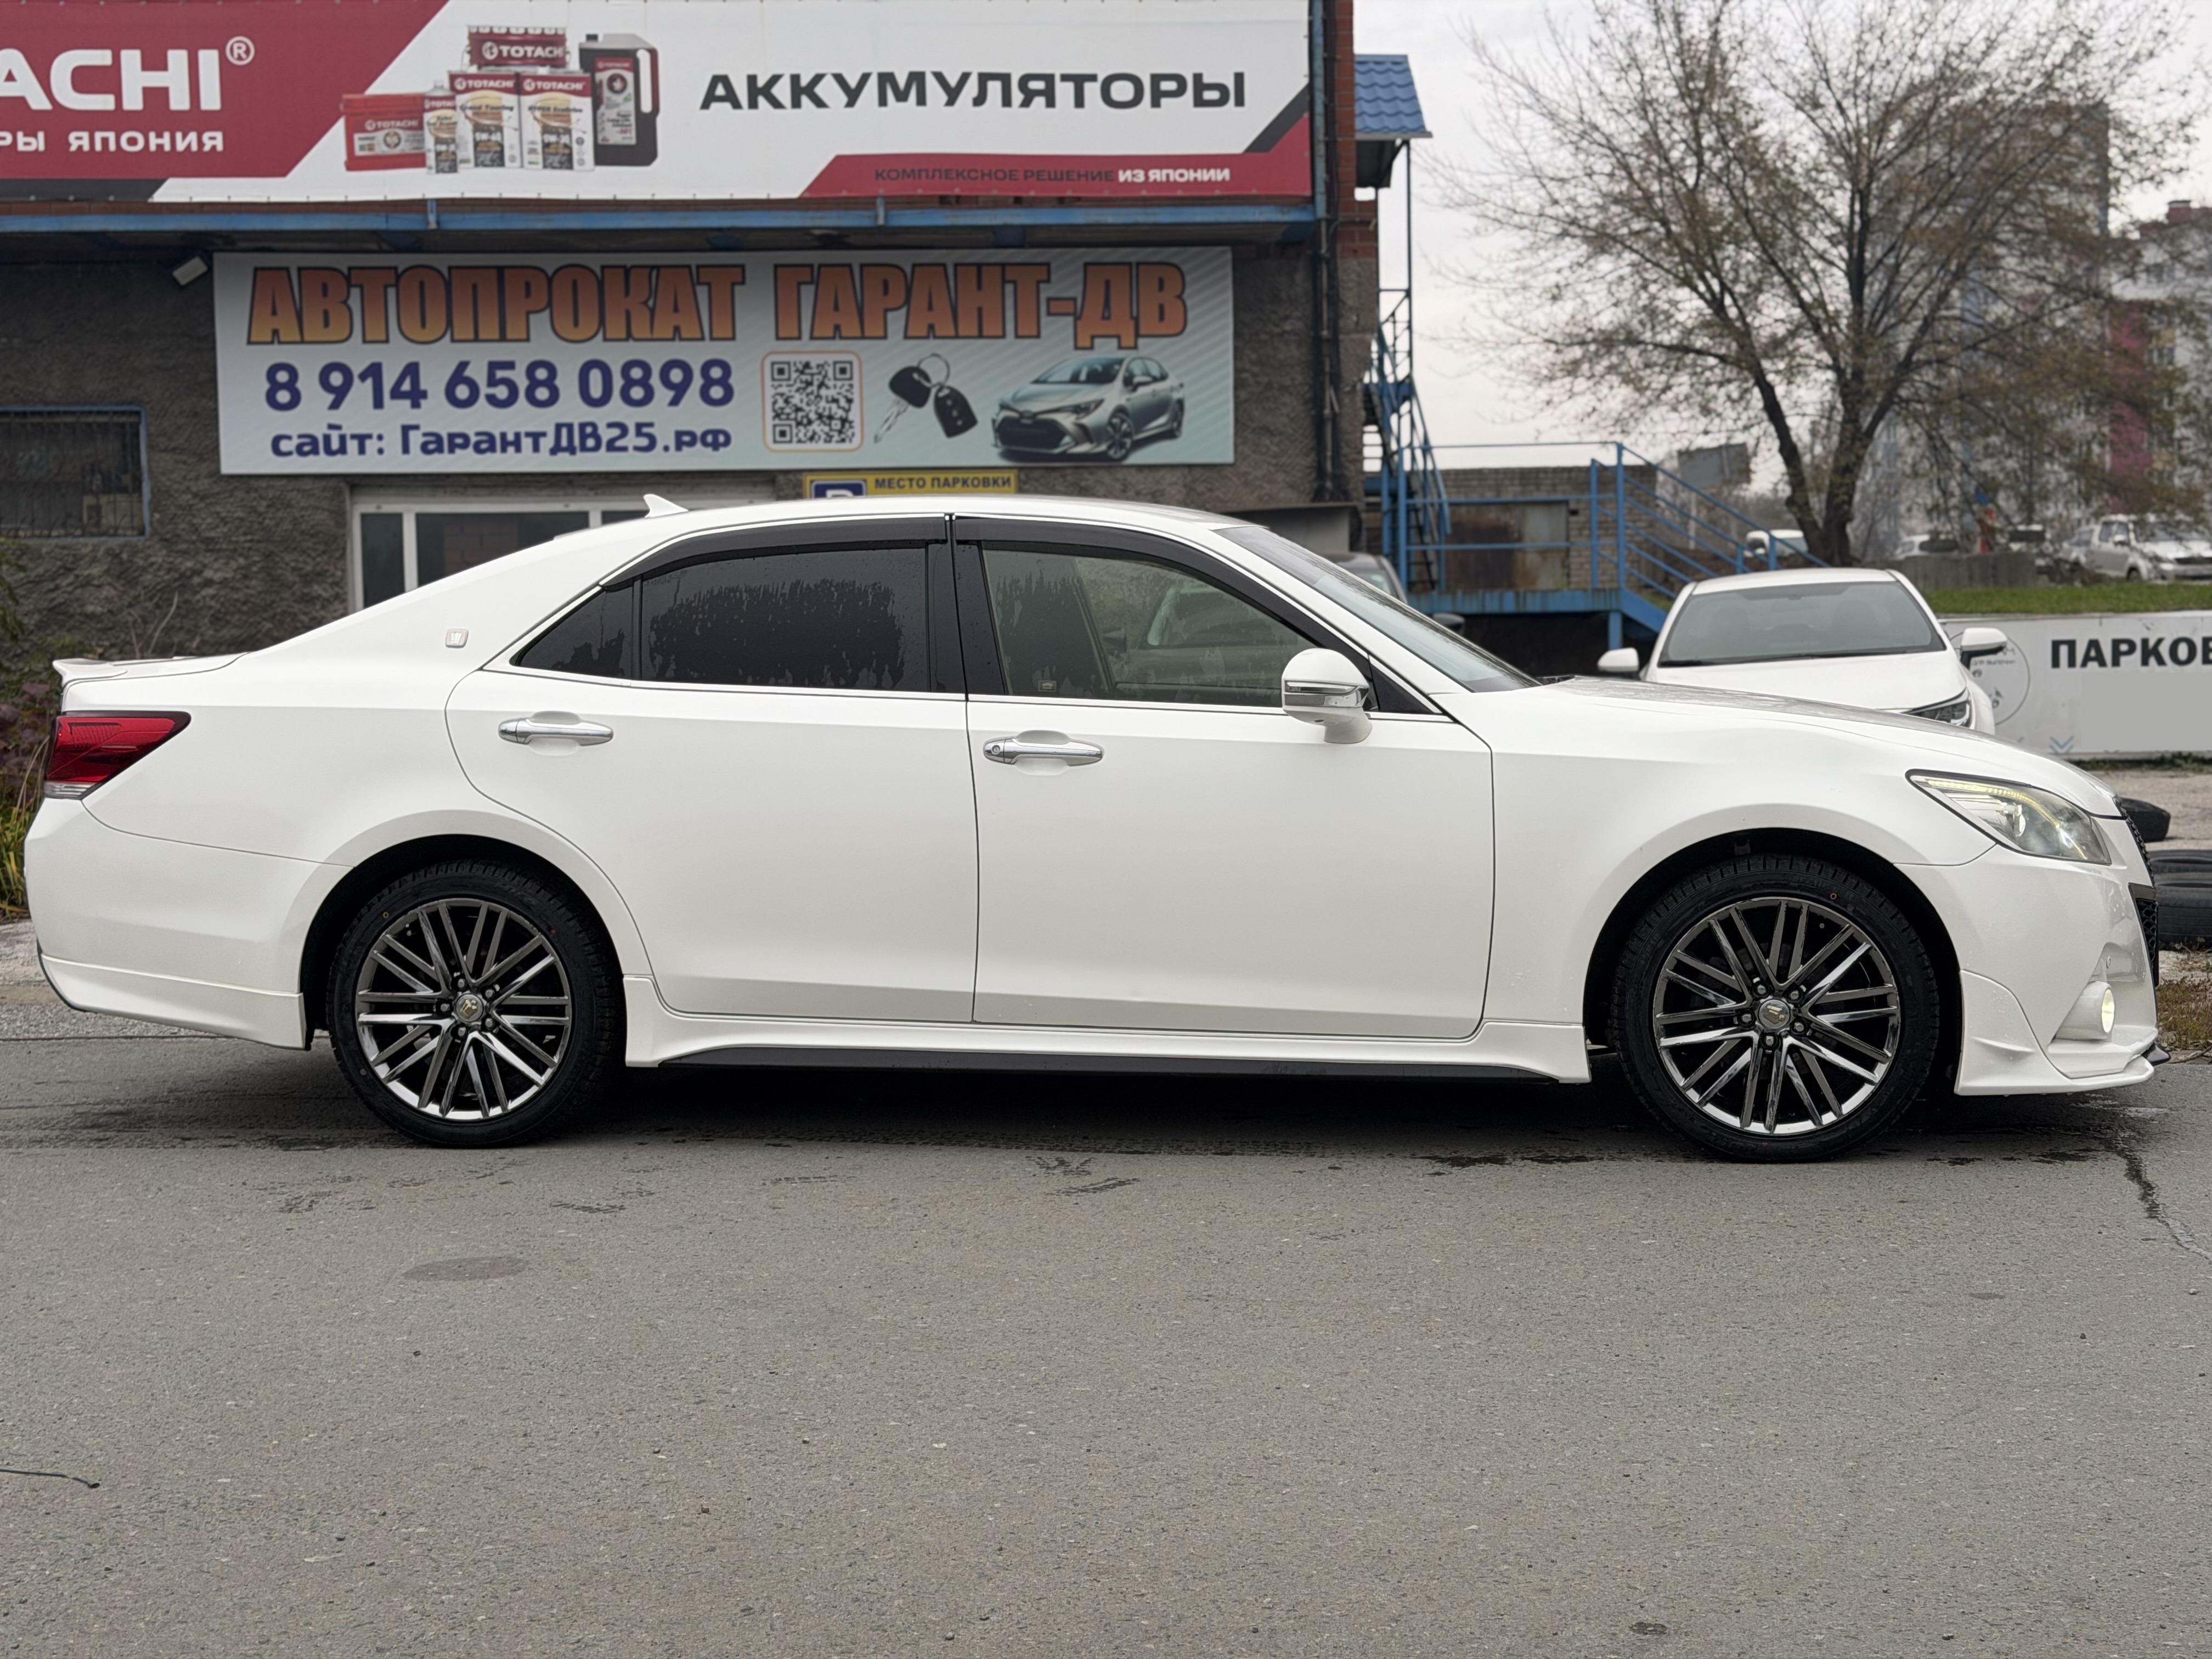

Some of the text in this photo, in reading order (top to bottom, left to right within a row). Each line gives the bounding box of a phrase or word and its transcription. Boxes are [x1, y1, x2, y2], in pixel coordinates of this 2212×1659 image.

[699, 71, 1245, 110] АККУМУЛЯТОРЫ
[68, 131, 223, 152] ЯПОНИЯ
[875, 168, 1231, 183] КОМПЛЕКСНОЕ РЕШЕНИЕ ИЗ ЯПОНИИ
[247, 261, 1187, 350] АВТОПРОКАТ ГАРАНТ-ДВ
[265, 358, 735, 411] 8 914 658 0898
[270, 421, 732, 457] сайт: ГарантДВ25.рф
[874, 476, 1011, 489] МЕСТО ПАРКОВКИ
